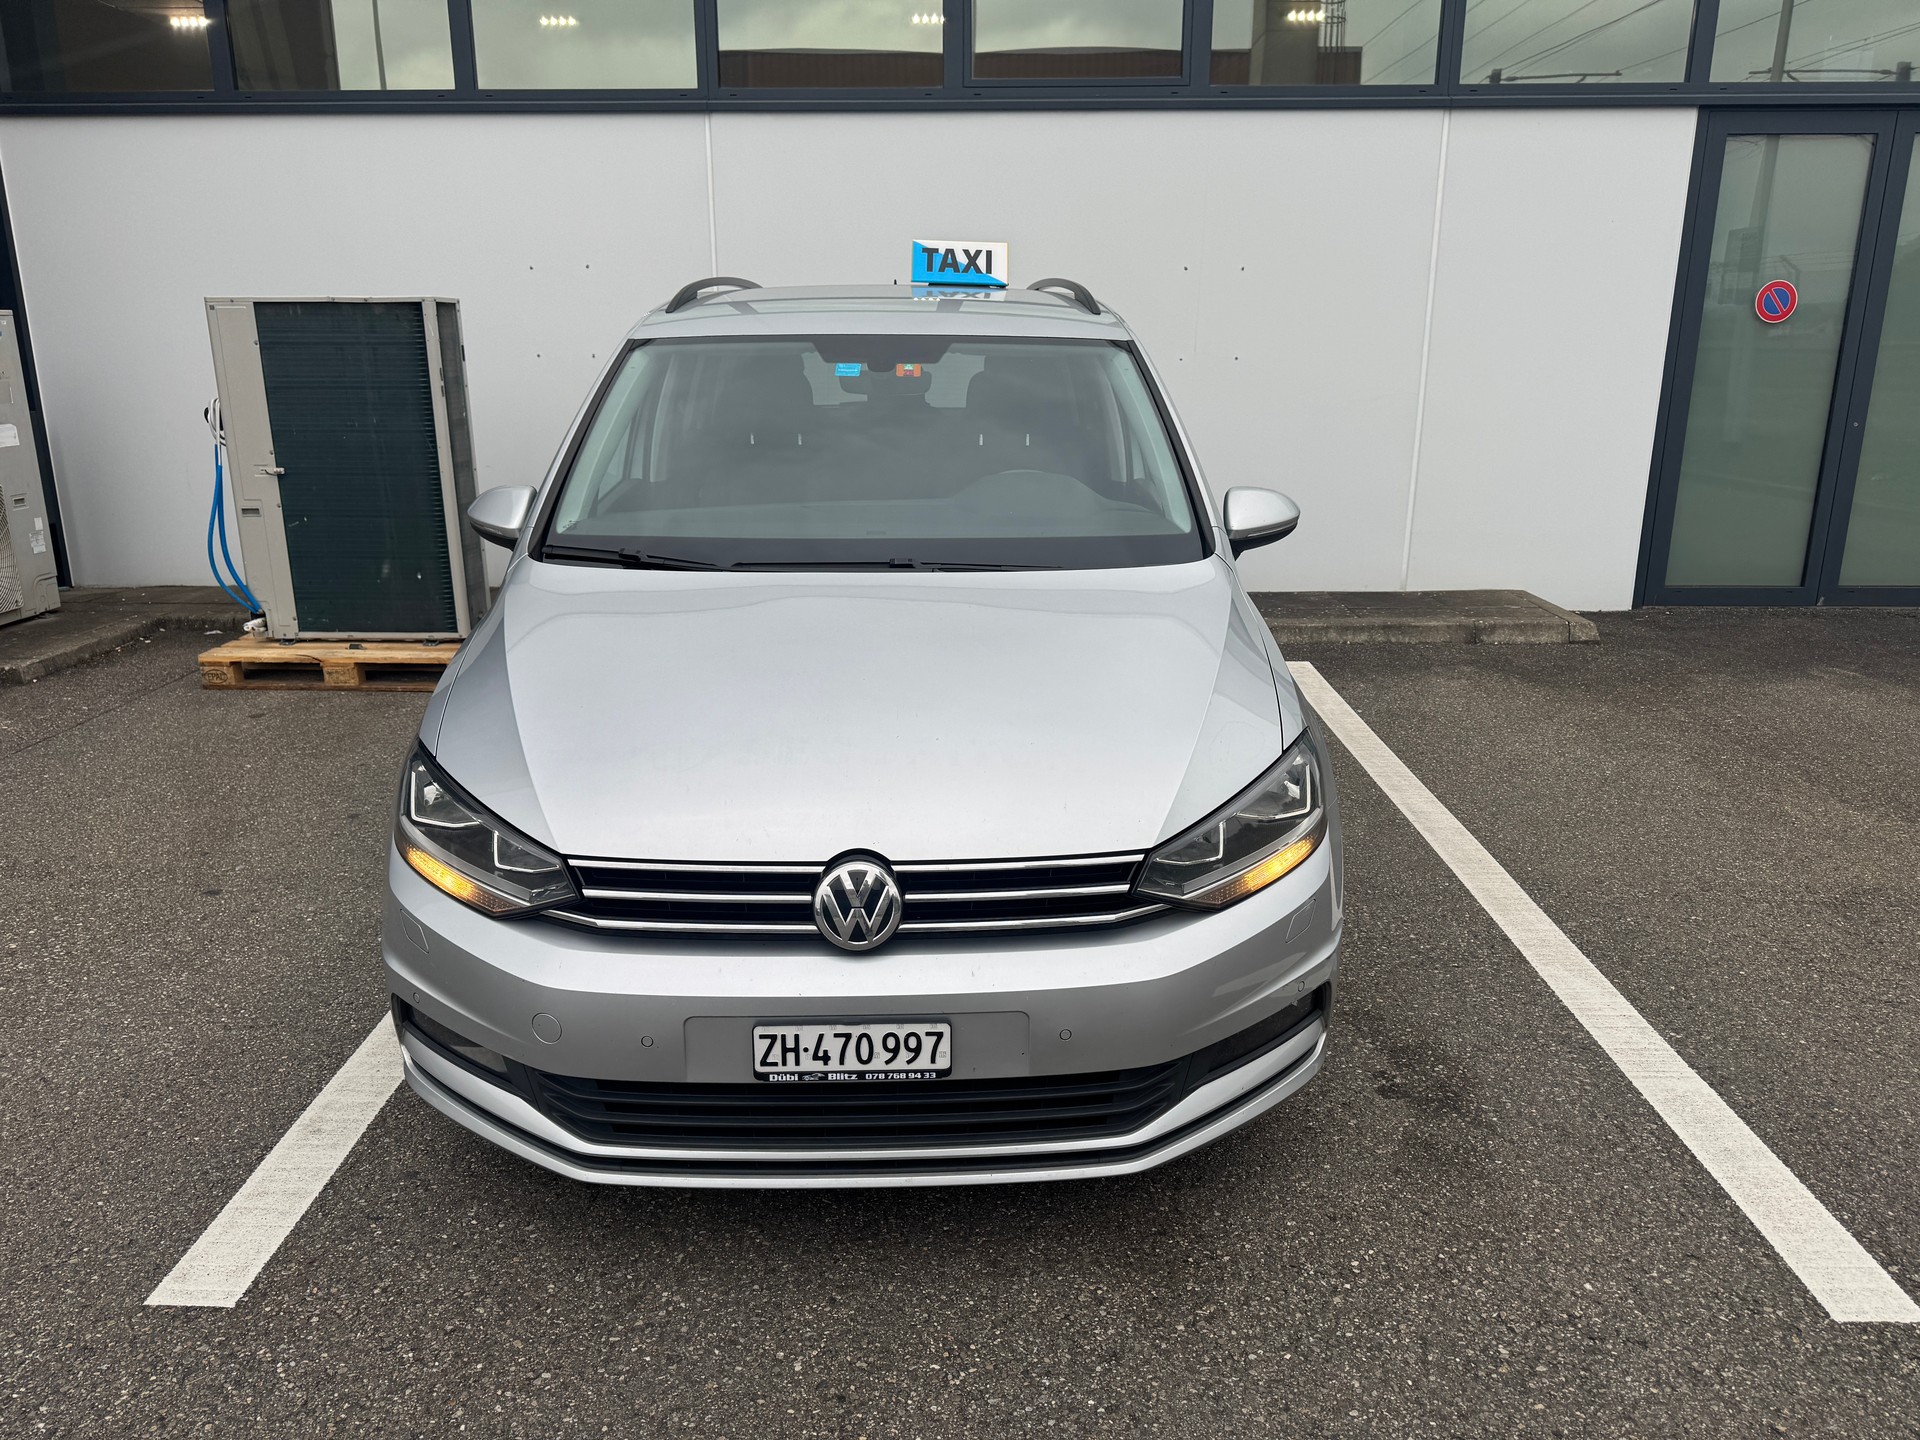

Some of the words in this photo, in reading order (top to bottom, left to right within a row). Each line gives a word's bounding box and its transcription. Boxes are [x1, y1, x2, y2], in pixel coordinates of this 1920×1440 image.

[922, 247, 993, 275] TAXI
[827, 1072, 858, 1081] Blitz
[865, 1072, 885, 1080] 078
[887, 1072, 906, 1080] 768
[908, 1071, 922, 1079] 94
[923, 1071, 937, 1079] 33
